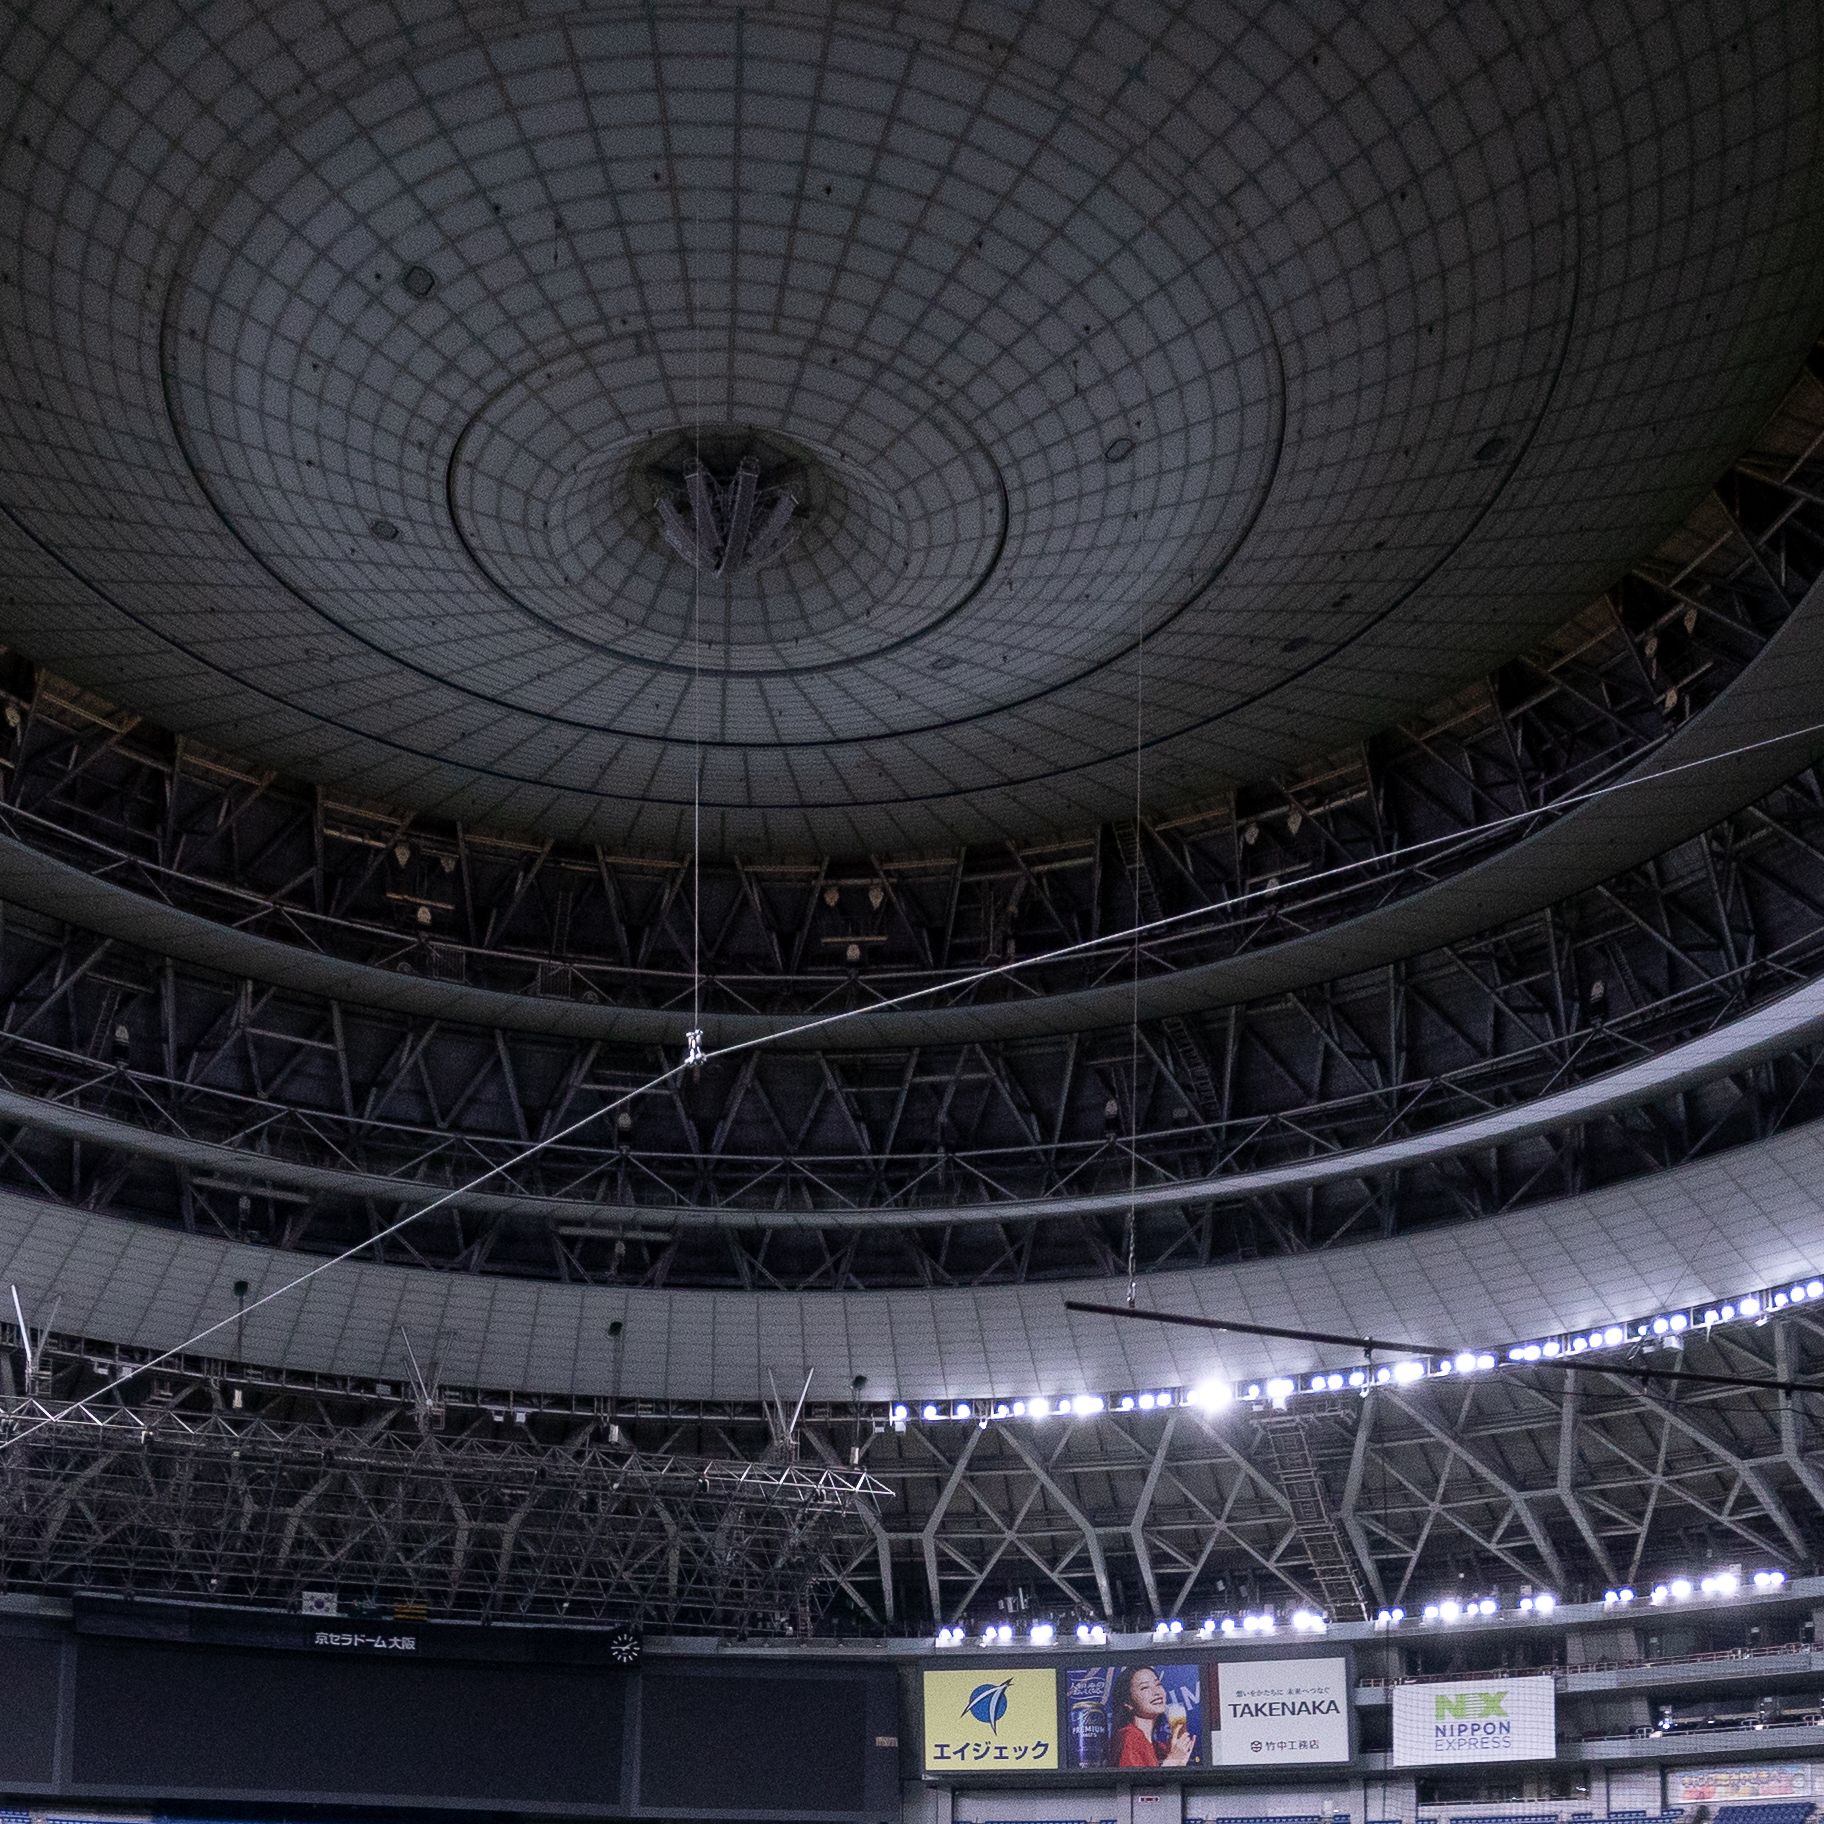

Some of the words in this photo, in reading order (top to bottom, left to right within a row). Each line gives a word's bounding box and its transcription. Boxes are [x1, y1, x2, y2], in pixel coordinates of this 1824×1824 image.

[314, 1632, 416, 1650] 京セラドーム大阪
[1227, 1699, 1341, 1719] TAKENAKA
[1434, 1721, 1512, 1737] NIPPON
[933, 1740, 1050, 1761] エイジェック
[1264, 1739, 1320, 1751] 竹中工務店
[1434, 1735, 1512, 1752] EXPRESS
